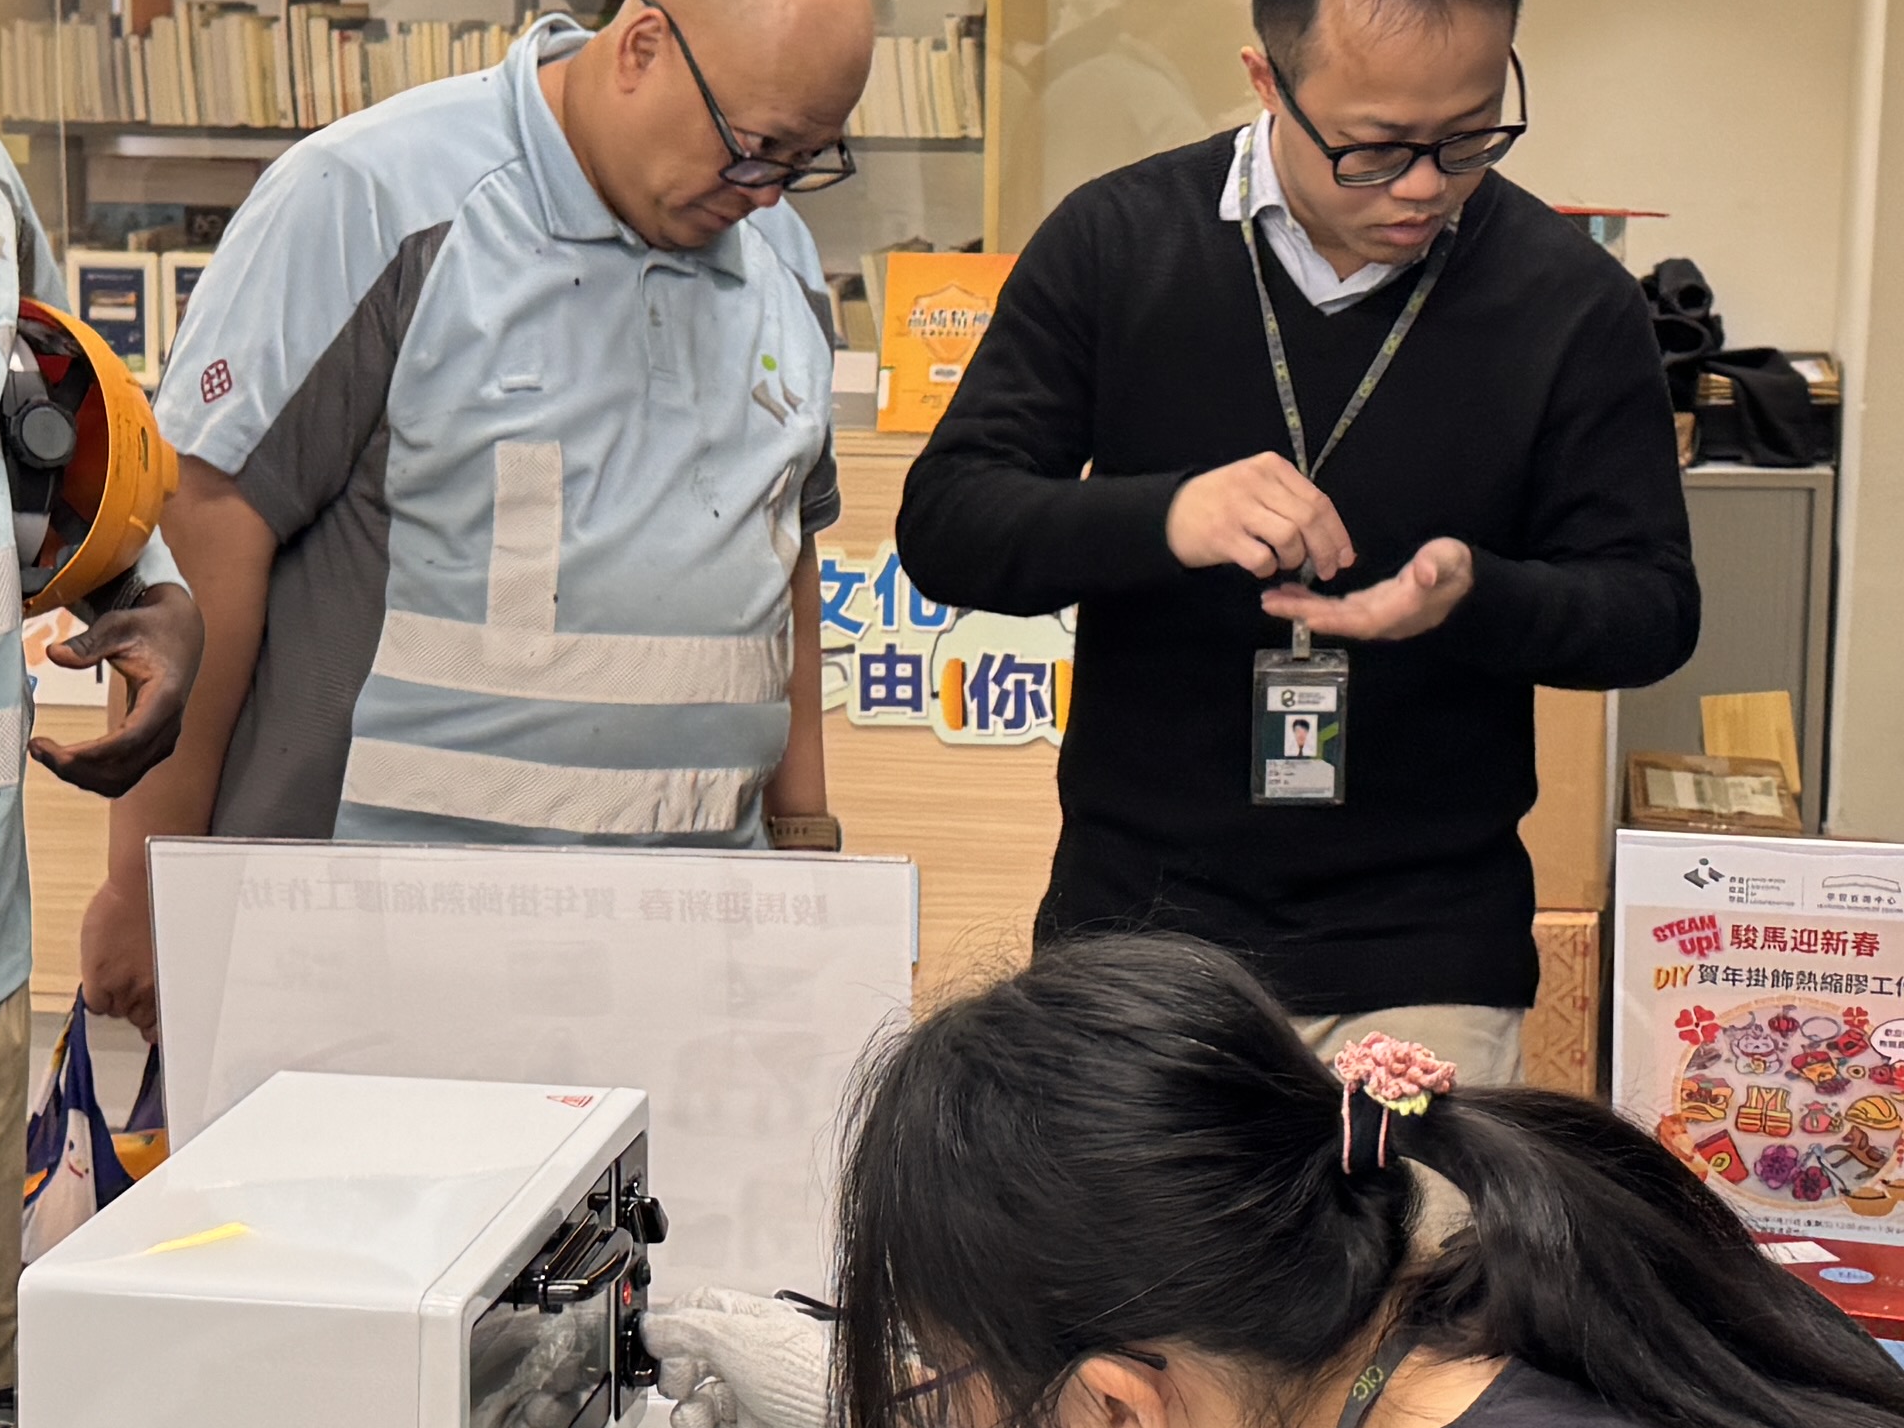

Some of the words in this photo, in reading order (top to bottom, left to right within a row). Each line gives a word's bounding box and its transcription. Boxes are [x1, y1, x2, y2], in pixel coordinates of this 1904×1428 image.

[1730, 923, 1881, 958] 駿馬迎新春
[1654, 964, 1695, 991] DIY
